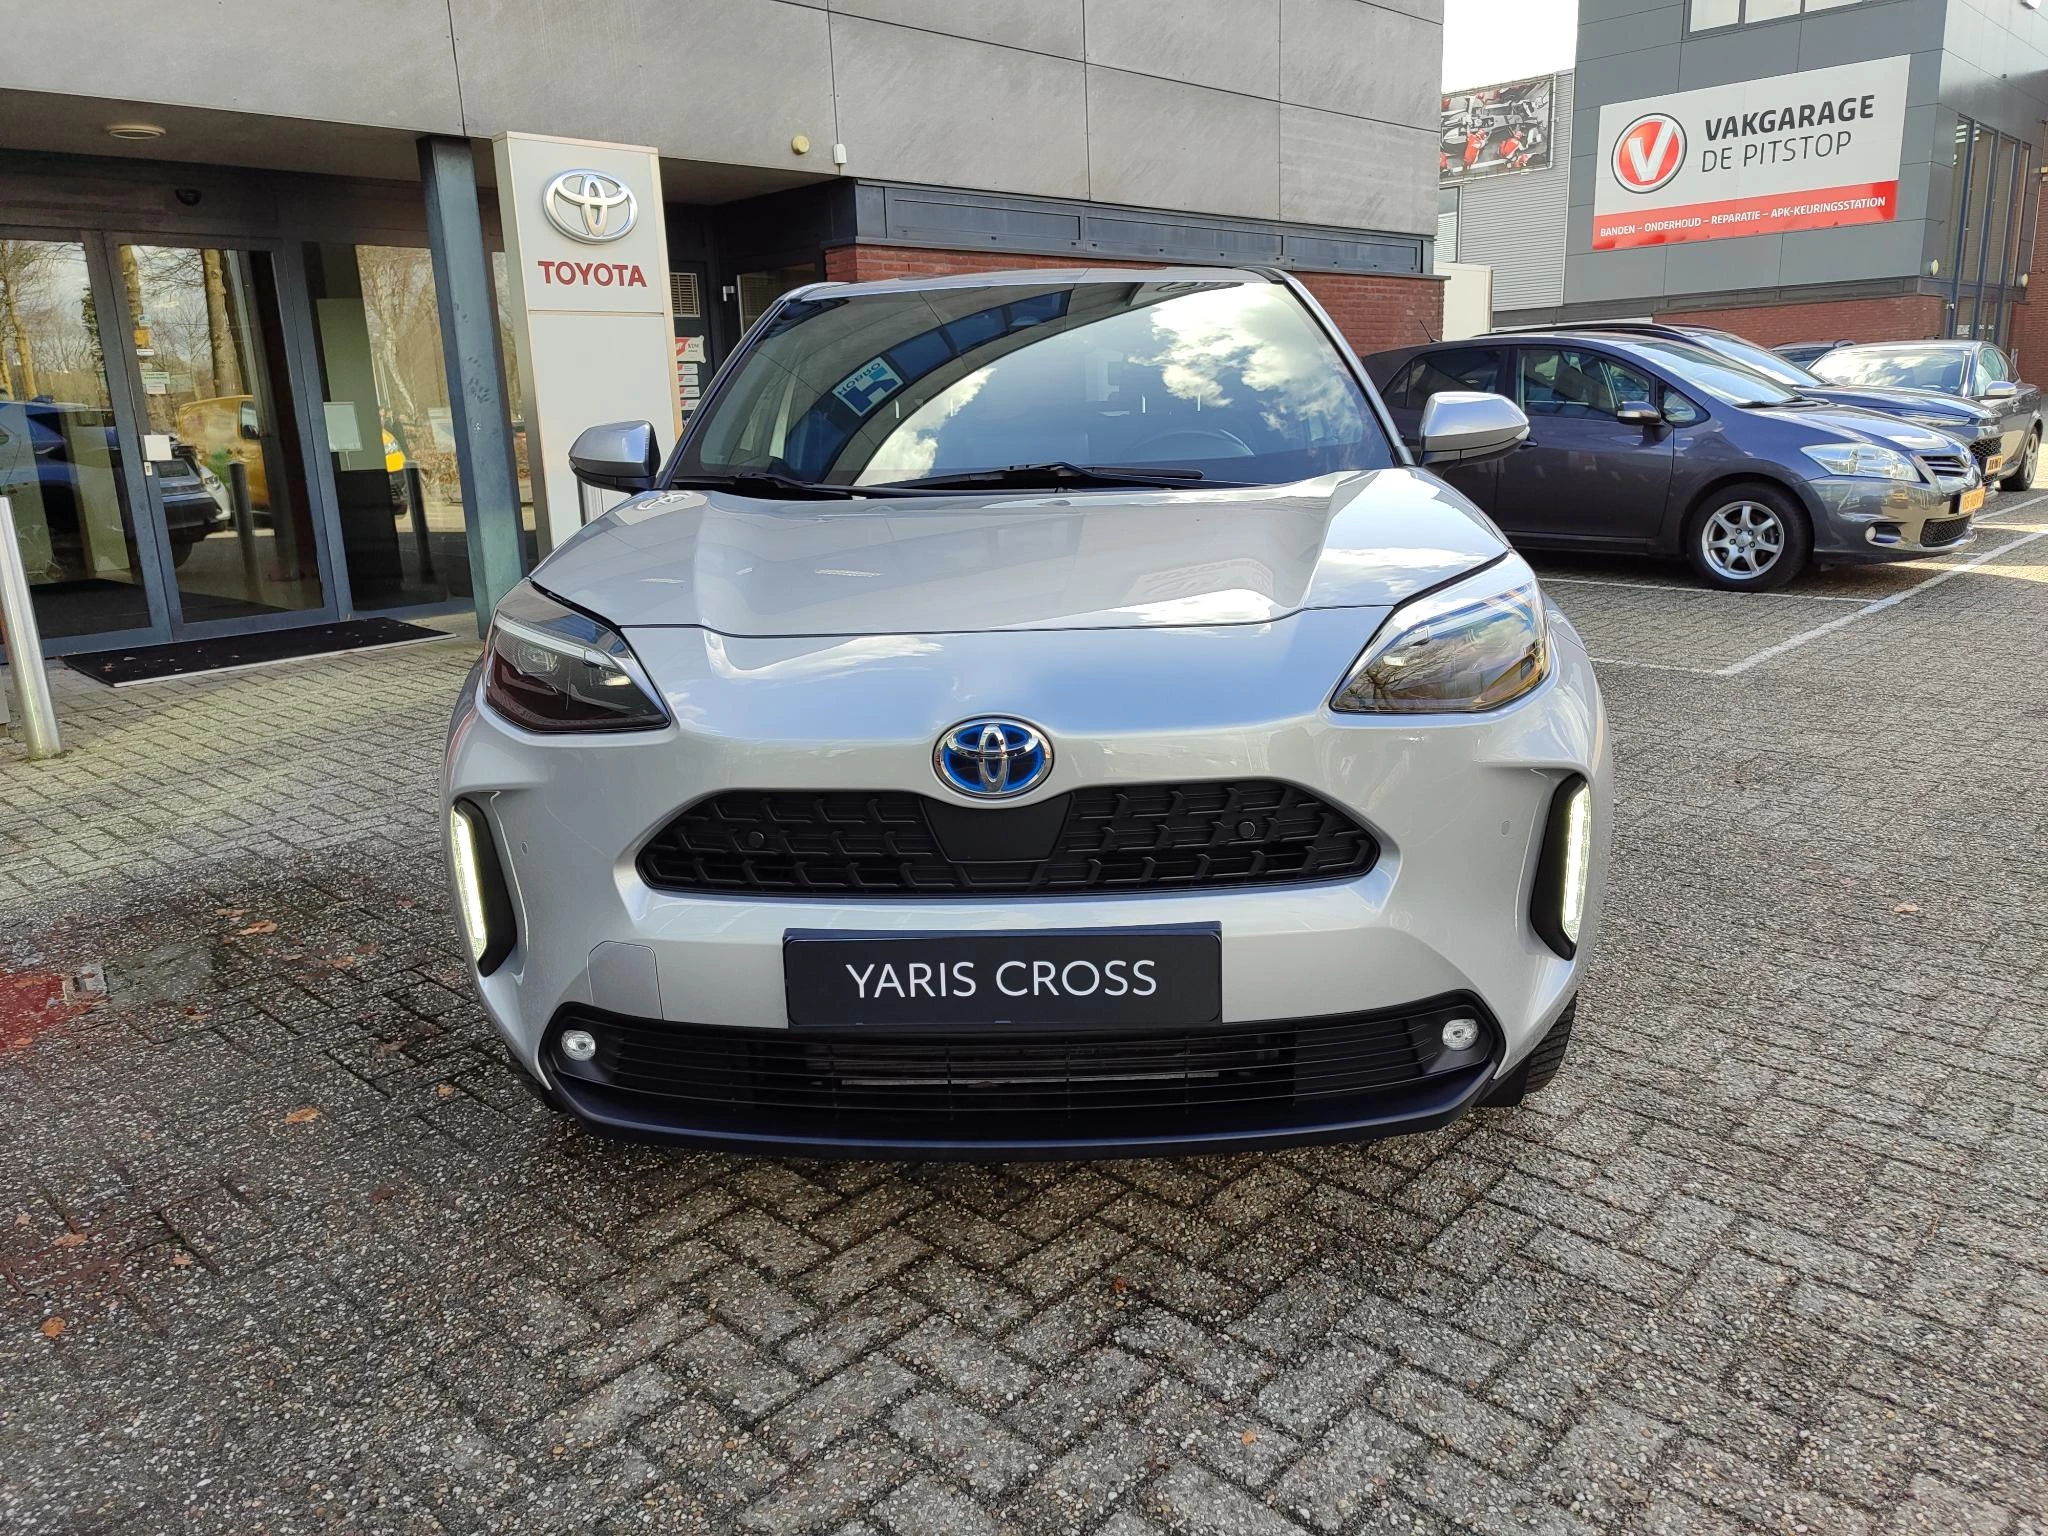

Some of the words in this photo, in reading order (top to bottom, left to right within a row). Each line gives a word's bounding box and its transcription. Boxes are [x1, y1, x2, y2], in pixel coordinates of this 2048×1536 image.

[1705, 95, 1875, 140] VAKGARAGE
[1702, 147, 1732, 172] DE
[1743, 130, 1852, 167] PITSTOP
[1600, 224, 1635, 237] BANDEN
[1645, 217, 1701, 232] ONDERHOUD
[1711, 210, 1761, 225] REPARATIE
[1771, 196, 1886, 218] APK-KEURINGSSTATION
[537, 260, 648, 288] TOYOTA
[846, 962, 976, 998] YARIS
[996, 960, 1157, 996] CROSS
